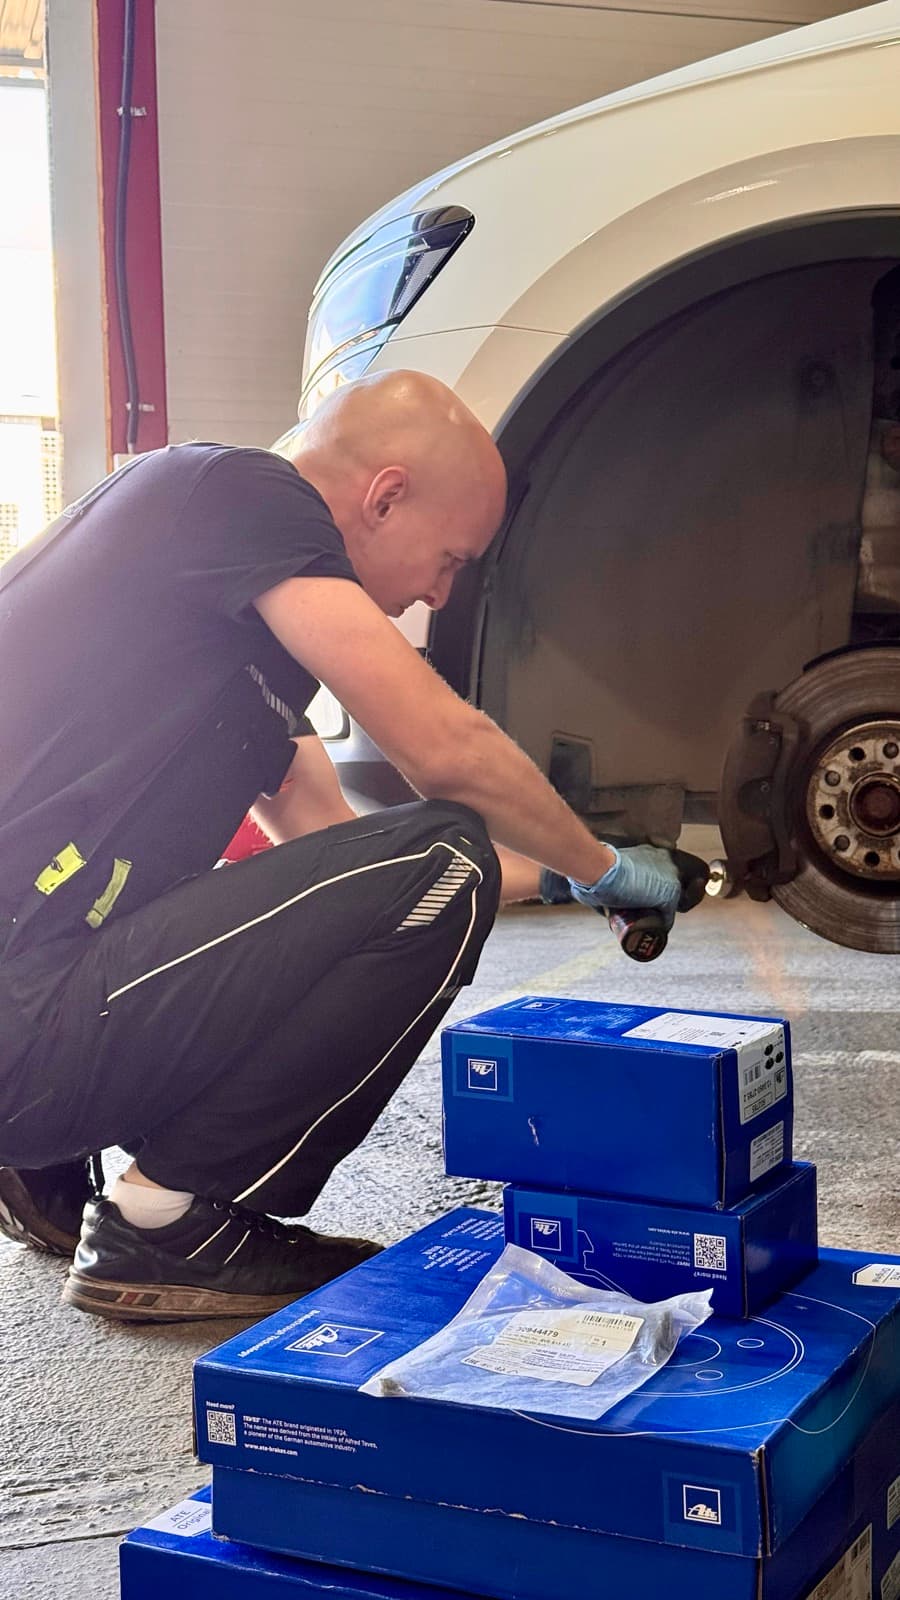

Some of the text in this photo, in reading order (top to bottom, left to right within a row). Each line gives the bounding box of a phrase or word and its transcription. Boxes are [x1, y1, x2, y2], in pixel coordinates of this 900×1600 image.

[206, 1400, 219, 1408] Need
[284, 1421, 299, 1429] brand
[300, 1424, 325, 1433] originated
[279, 1428, 297, 1436] derived
[345, 1438, 360, 1446] Alfred
[284, 1435, 303, 1444] German
[305, 1440, 333, 1448] automotive
[244, 1443, 298, 1456] www.ate-brakes.com
[170, 1510, 191, 1522] ATE
